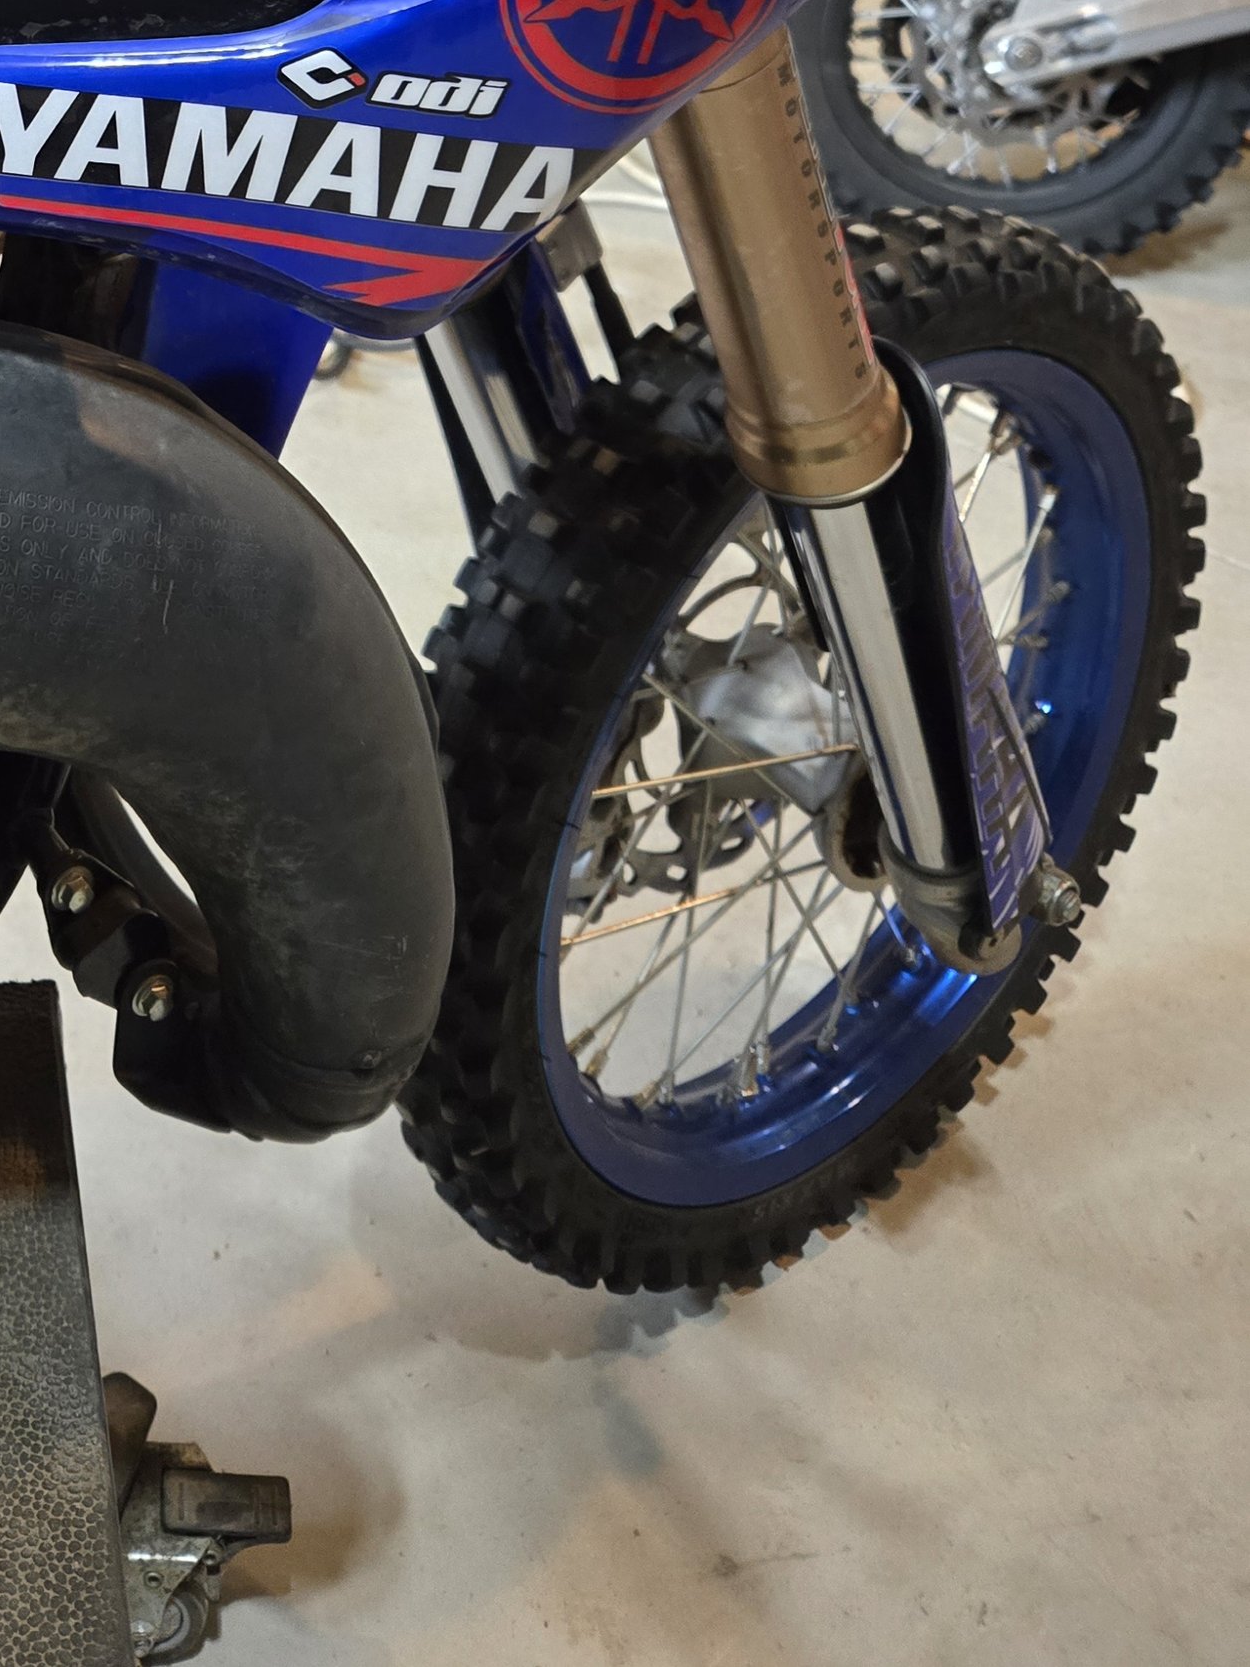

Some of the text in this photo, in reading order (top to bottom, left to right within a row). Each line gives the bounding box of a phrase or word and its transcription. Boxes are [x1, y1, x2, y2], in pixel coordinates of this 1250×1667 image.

[370, 73, 508, 116] odi
[86, 500, 159, 525] CONTROL
[20, 515, 57, 535] FOR
[65, 520, 101, 540] USE
[111, 527, 134, 545] ON
[20, 538, 68, 560] ONLY
